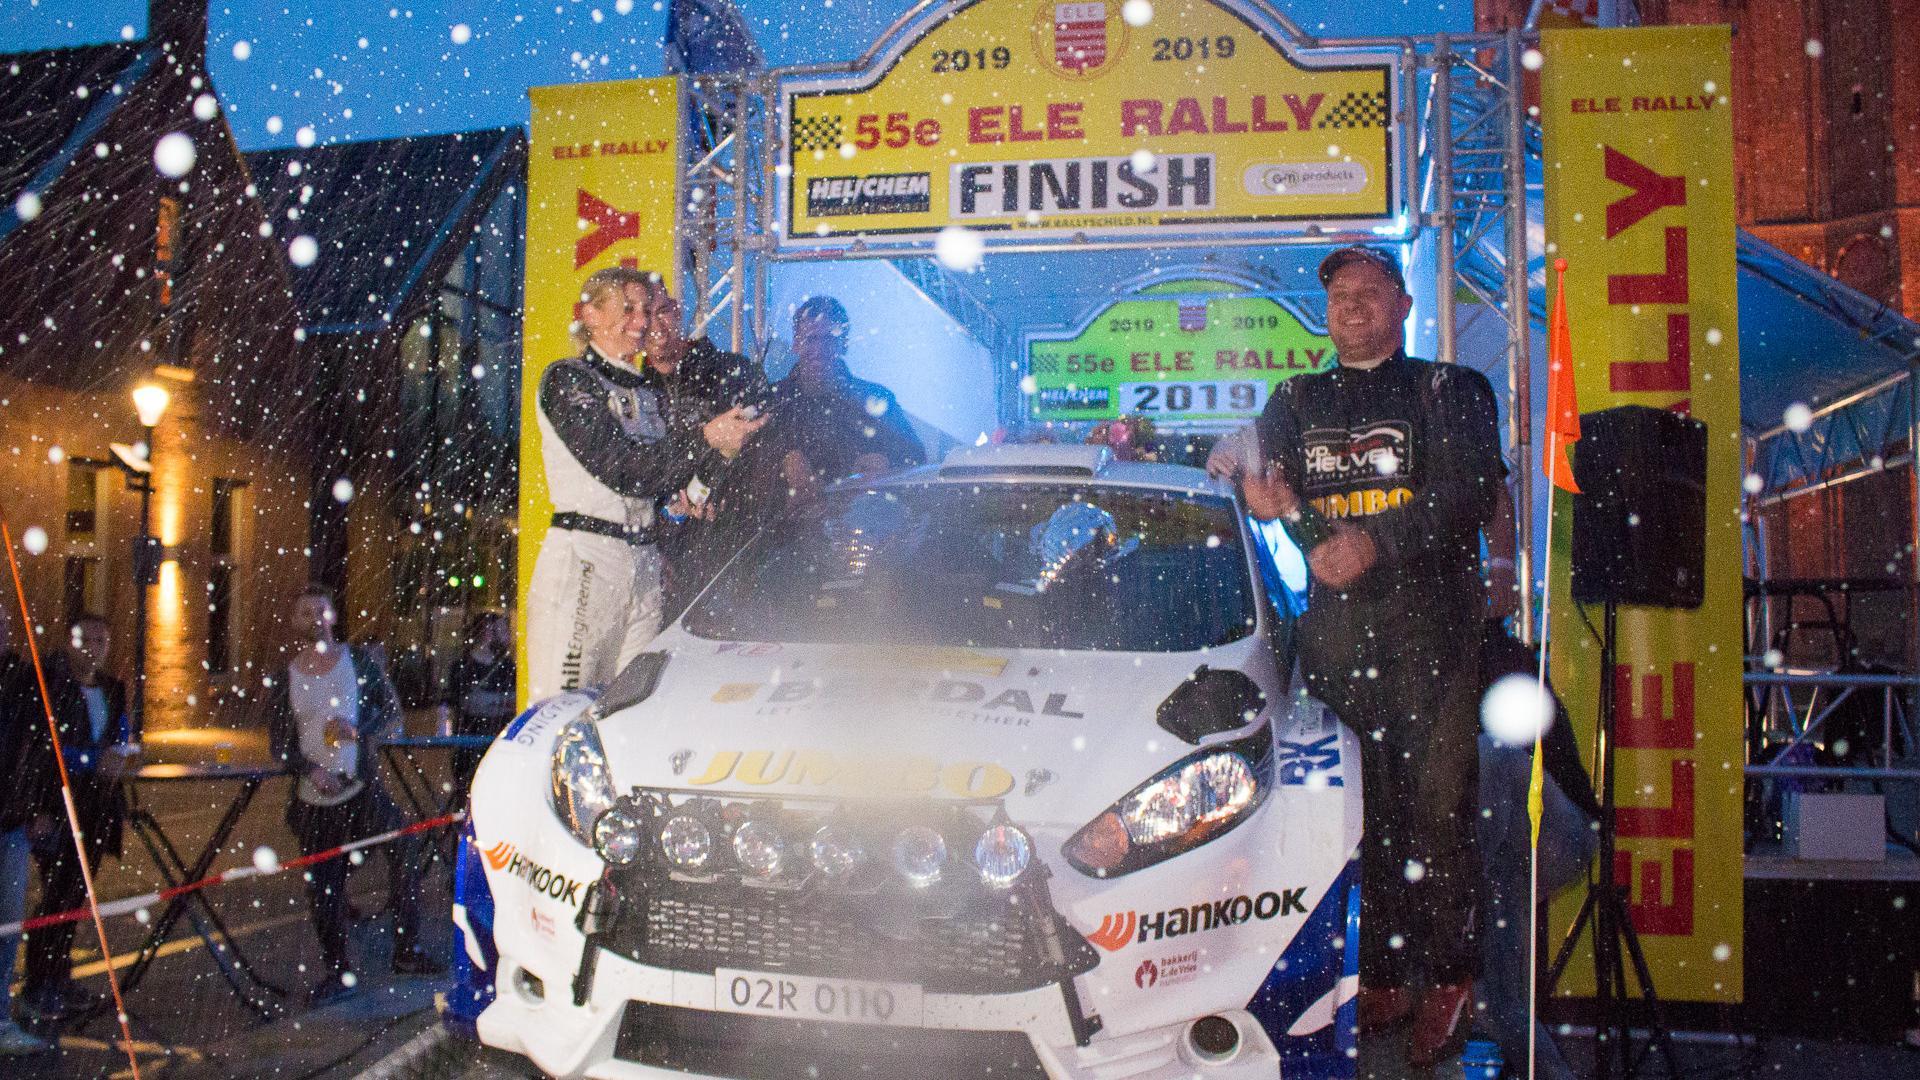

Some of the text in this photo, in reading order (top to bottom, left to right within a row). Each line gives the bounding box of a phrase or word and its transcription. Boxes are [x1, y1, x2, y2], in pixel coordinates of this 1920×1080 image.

[931, 37, 1235, 73] 2019 2019
[1571, 94, 1716, 114] ELE RALLY
[855, 92, 1326, 151] 55e ELE RALLY
[554, 140, 669, 160] ELE RALLY
[960, 157, 1211, 214] FINISH
[1604, 144, 1692, 418] LLY
[1109, 315, 1279, 333] 2019 2019
[1066, 347, 1327, 374] 55e ELE RALLY
[1133, 384, 1257, 412] 2019
[766, 680, 1085, 720] BDAL
